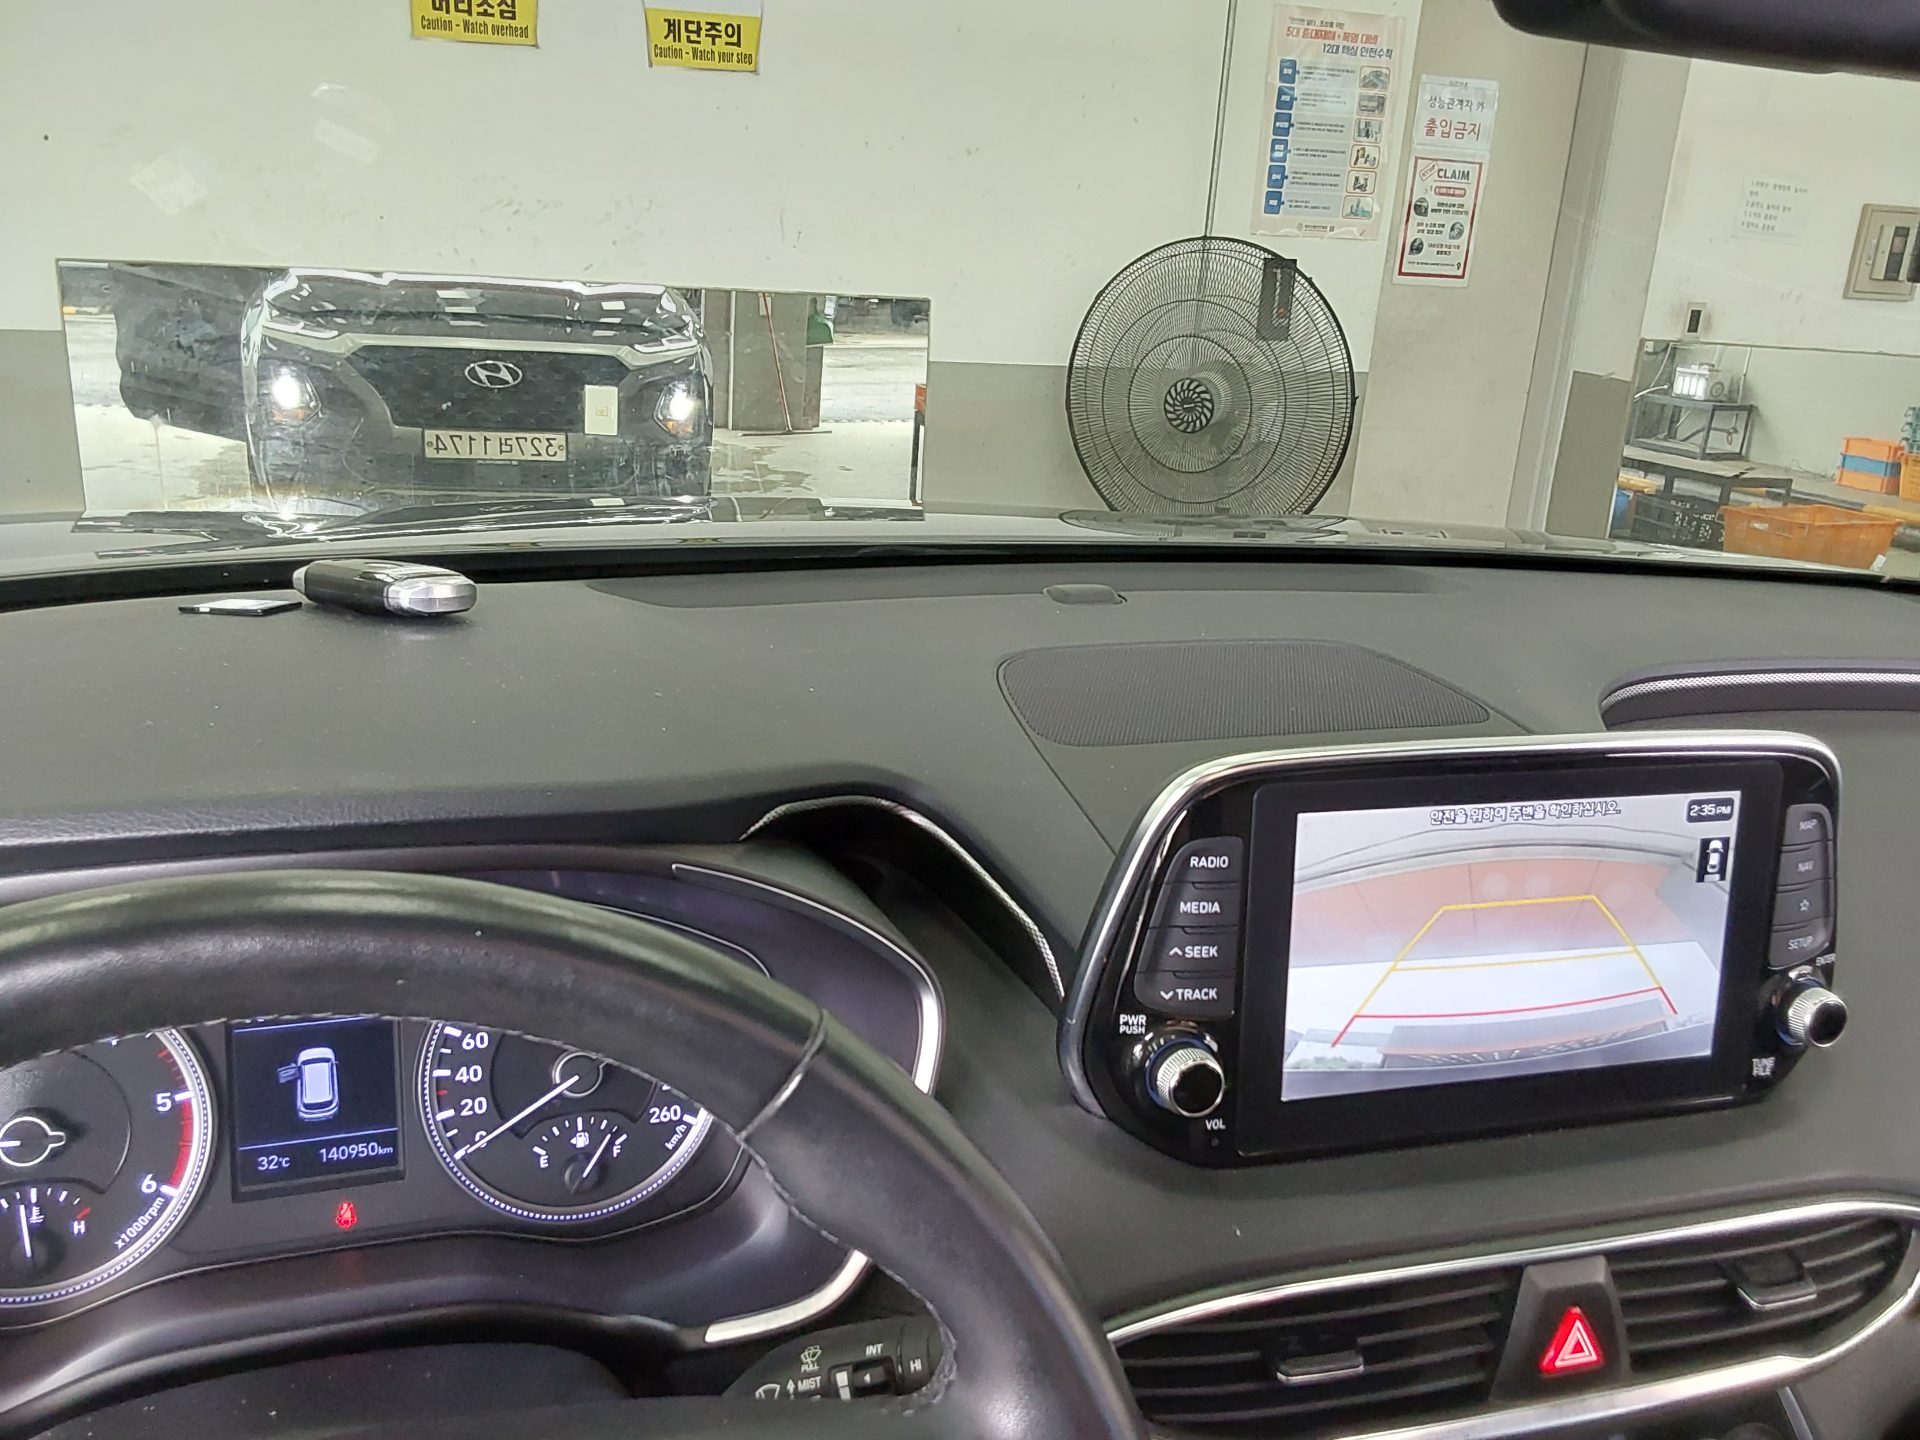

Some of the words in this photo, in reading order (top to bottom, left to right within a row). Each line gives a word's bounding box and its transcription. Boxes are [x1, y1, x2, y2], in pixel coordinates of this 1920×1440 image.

[421, 15, 453, 32] Caution
[462, 18, 488, 35] Watch
[491, 23, 529, 39] overhead
[663, 18, 742, 48] 계단주의
[653, 43, 683, 60] Caution
[691, 46, 716, 62] Watch
[717, 50, 734, 64] your
[736, 52, 753, 66] step
[1322, 43, 1340, 54] 12대
[1424, 117, 1481, 142] 출입금지
[1437, 168, 1471, 181] CLAIM
[1430, 807, 1468, 825] 안전을
[1470, 806, 1507, 823] 위하여
[1509, 804, 1547, 821] 주변을
[1549, 800, 1621, 819] 확인하십시오.
[1689, 803, 1715, 817] 2:35
[1716, 805, 1732, 815] PM
[1799, 819, 1817, 831] MAP
[1190, 855, 1229, 869] RADIO
[1797, 860, 1815, 872] NAV
[1179, 900, 1221, 914] MEDIA
[1787, 935, 1814, 951] SETUP
[1185, 945, 1218, 958] SEEK
[1176, 988, 1218, 1001] TRACK
[1119, 1014, 1147, 1026] PWR
[1119, 1025, 1146, 1035] PUSH
[461, 1031, 489, 1050] 60
[455, 1064, 483, 1083] 40
[156, 1092, 173, 1112] 5
[460, 1096, 488, 1117] 20
[649, 1104, 681, 1124] 260
[1205, 1118, 1226, 1131] VOL
[665, 1124, 687, 1150] km/h
[612, 1144, 621, 1157] F
[539, 1155, 549, 1168] E
[141, 1175, 158, 1194] 6
[73, 1219, 86, 1235] H
[114, 1195, 166, 1250] x1000rpm
[865, 1343, 884, 1357] INT
[801, 1362, 819, 1373] PULL
[910, 1358, 922, 1373] HI
[797, 1375, 822, 1391] MIST
